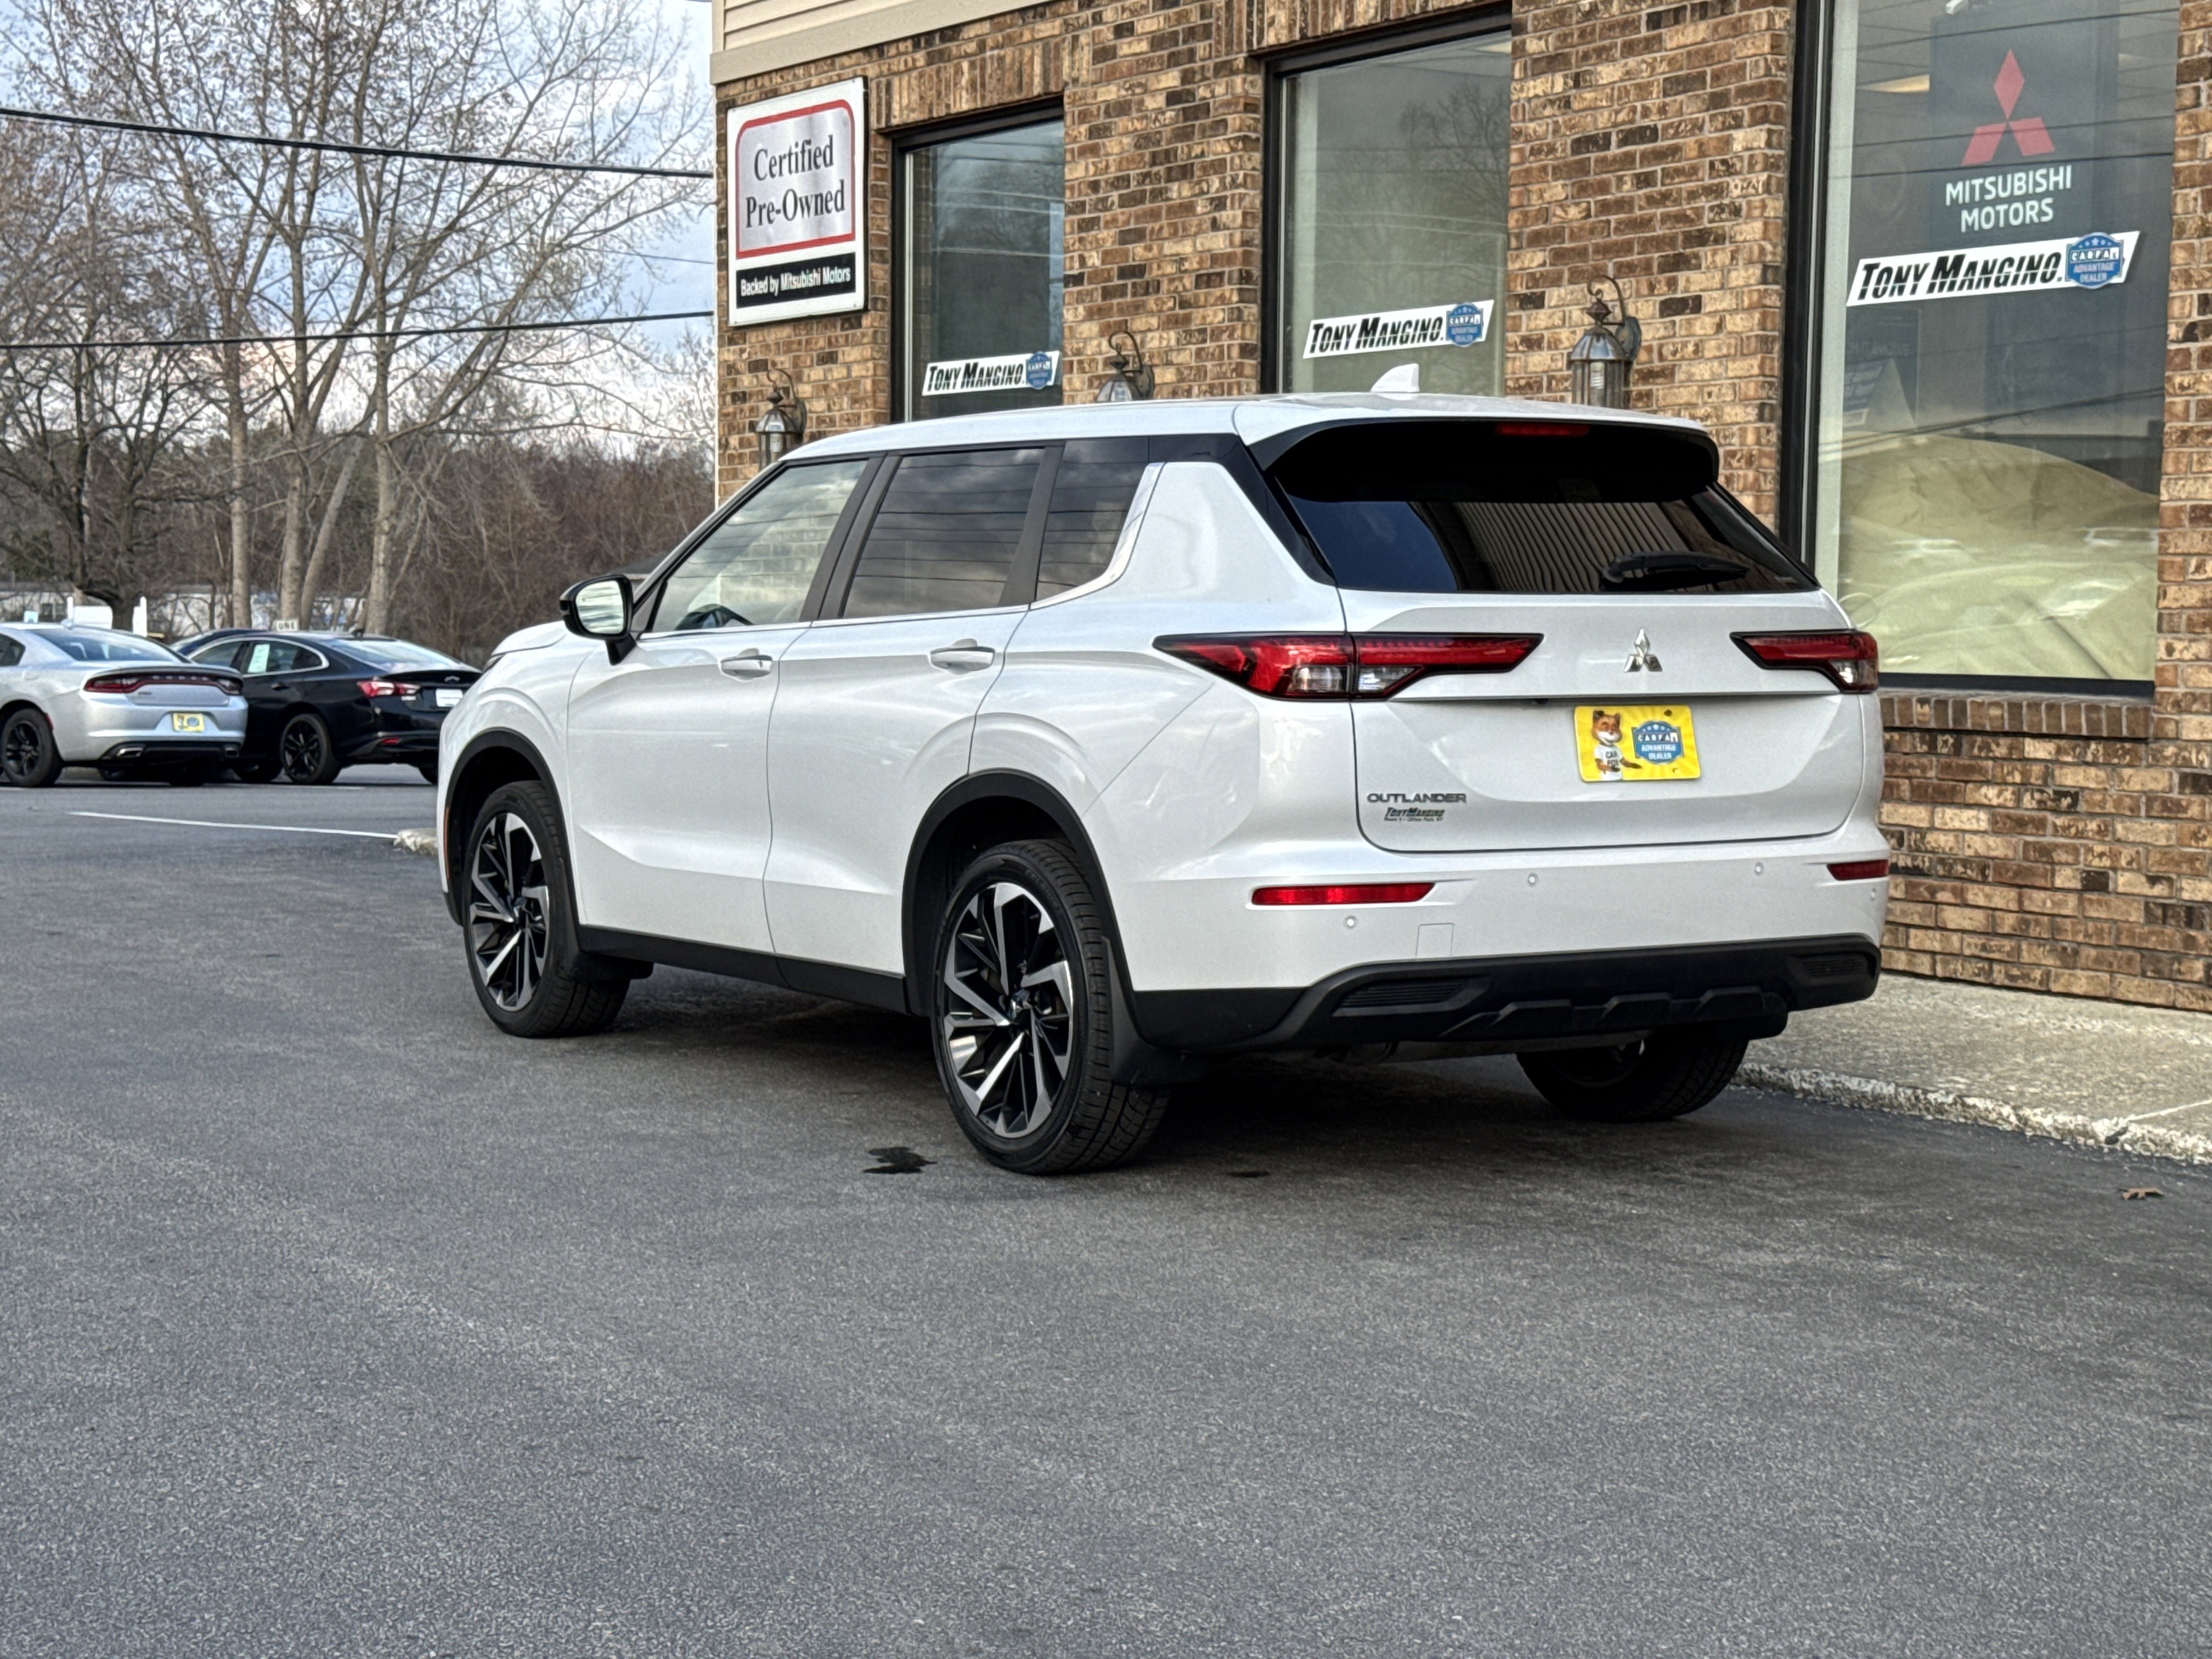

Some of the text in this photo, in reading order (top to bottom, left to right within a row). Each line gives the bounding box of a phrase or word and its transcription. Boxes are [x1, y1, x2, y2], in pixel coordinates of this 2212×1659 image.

[754, 134, 834, 181] Certified
[745, 179, 845, 228] Pre-Owned
[1946, 165, 2072, 206] MITSUBISHI
[1960, 197, 2054, 233] MOTORS
[741, 266, 851, 297] Backed by Mitsubishi Motors
[1857, 262, 1931, 301] TONY
[1310, 322, 1357, 354] TONY
[927, 366, 962, 392] TONY
[1367, 793, 1467, 803] OUTLANDER
